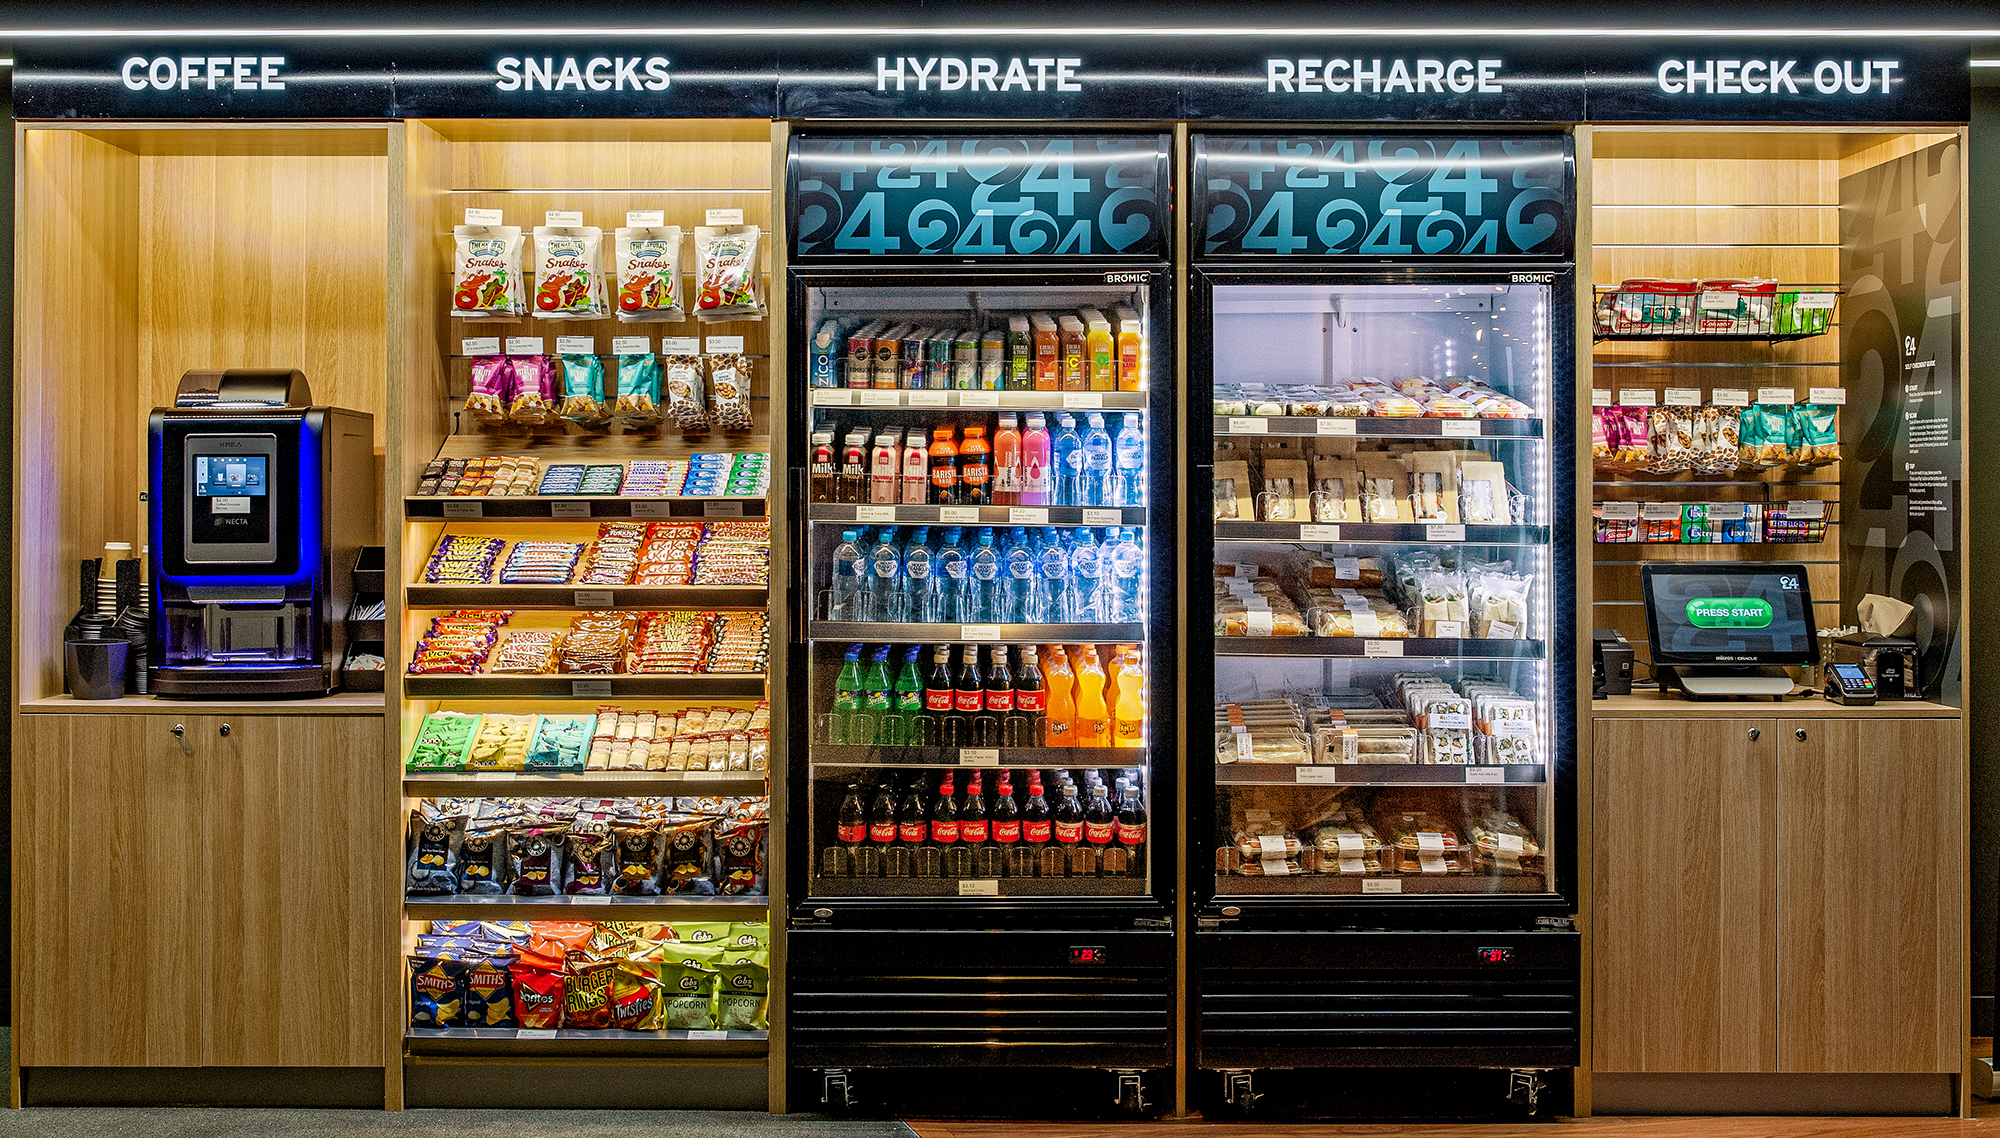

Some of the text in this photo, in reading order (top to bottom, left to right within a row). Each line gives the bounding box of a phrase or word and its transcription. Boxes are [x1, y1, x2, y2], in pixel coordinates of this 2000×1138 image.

[121, 56, 286, 91] COFFEE
[495, 56, 672, 92] SNACKS
[876, 57, 1083, 94] HYDRATE
[1267, 57, 1504, 95] RECHARGE
[1657, 59, 1900, 95] CHECK OUT
[465, 258, 507, 269] Snakes
[546, 258, 588, 269] Snakes
[628, 258, 670, 270] Snakes
[1107, 273, 1147, 283] BROMIC
[1511, 273, 1552, 283] BROMIC
[1904, 335, 1916, 356] 24
[818, 354, 829, 386] ZICO
[812, 463, 834, 474] Milk
[842, 464, 864, 474] Milk
[872, 466, 894, 476] Milk
[904, 465, 926, 476] Milk
[932, 469, 956, 479] BARISTA
[964, 466, 988, 477] BARISTA
[1779, 576, 1800, 590] 24
[1696, 608, 1764, 618] PRESS START
[692, 930, 713, 940] Cobs
[738, 934, 758, 946] Cobs
[417, 974, 455, 990] SMITH'S
[469, 972, 504, 986] SMITH'S
[566, 967, 615, 993] BURGER
[680, 976, 698, 989] Cobs
[732, 975, 752, 988] Cobs
[566, 987, 608, 1012] RINGS
[668, 1000, 707, 1009] POPCORN
[722, 998, 760, 1008] POPCORN
[615, 997, 653, 1019] Twisties
